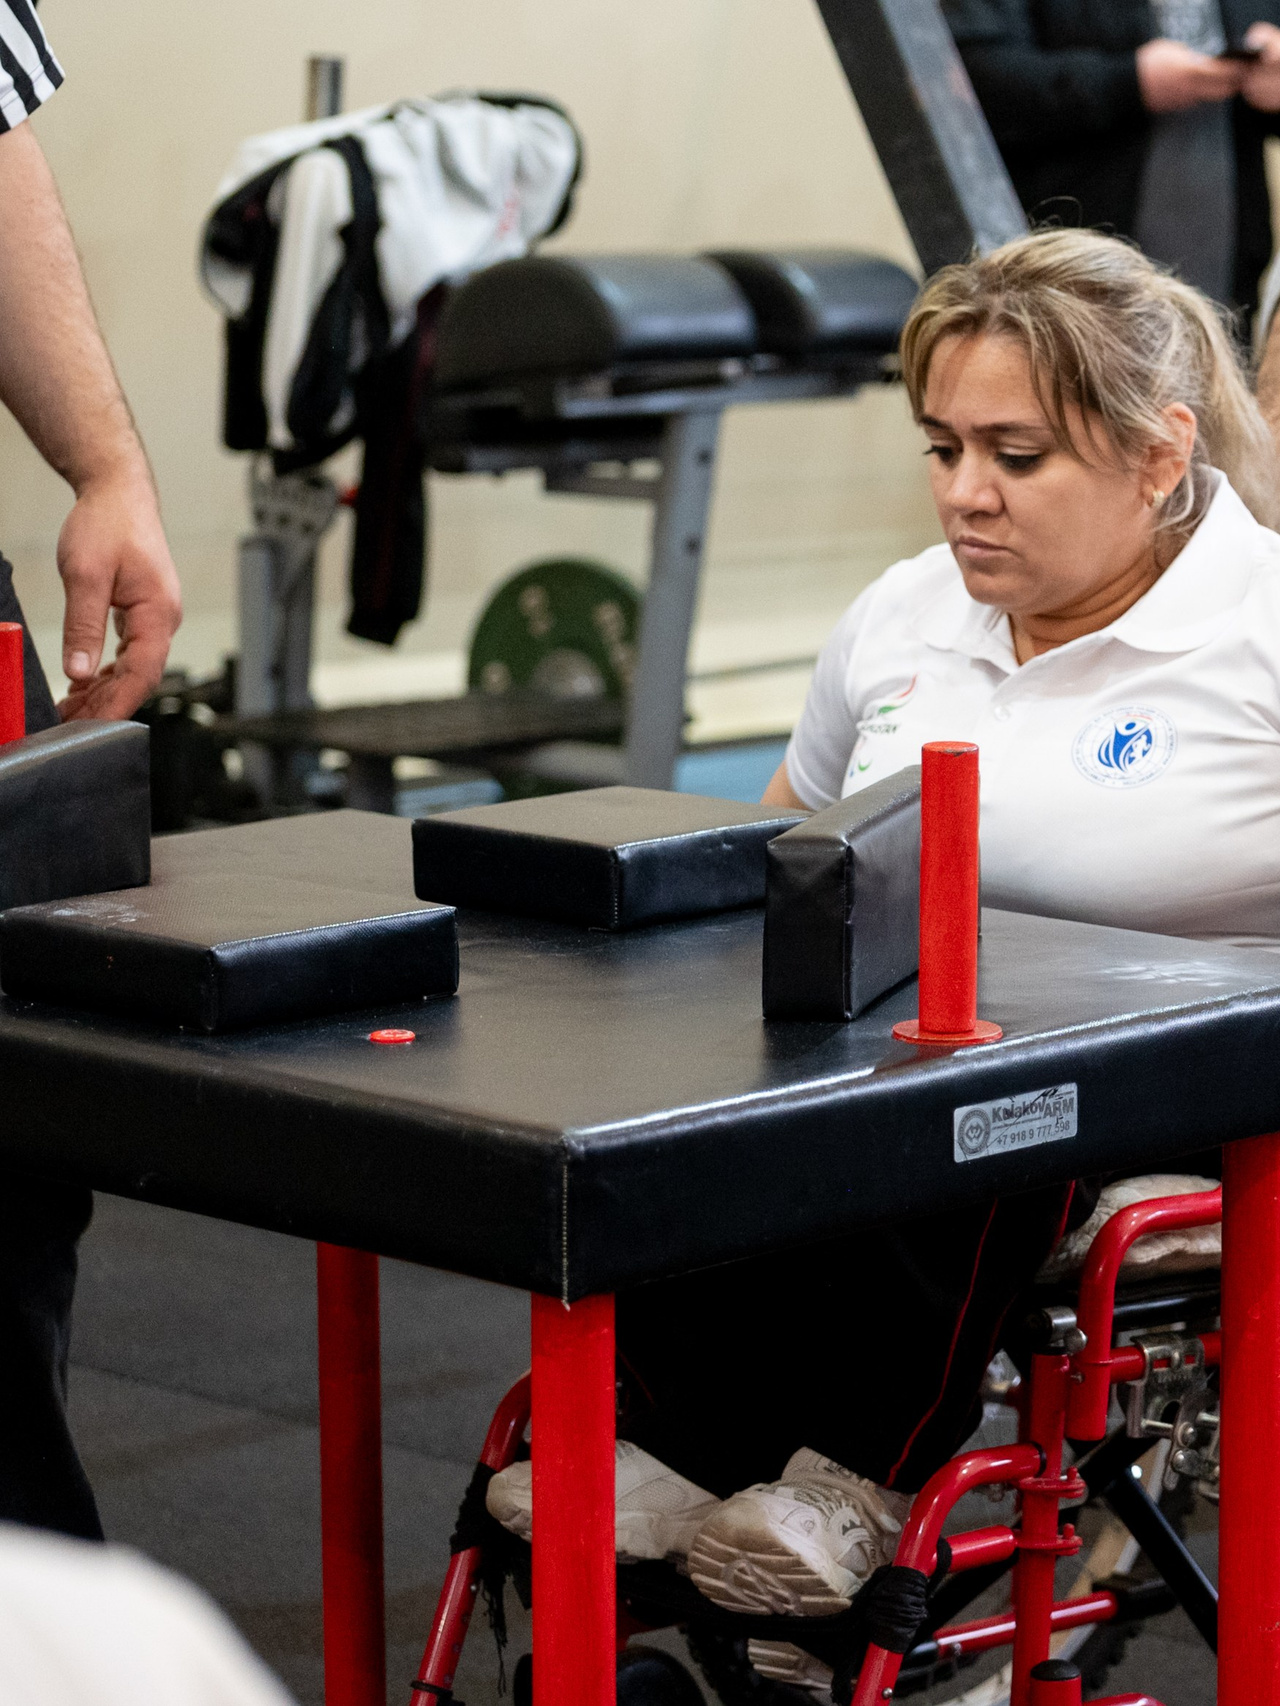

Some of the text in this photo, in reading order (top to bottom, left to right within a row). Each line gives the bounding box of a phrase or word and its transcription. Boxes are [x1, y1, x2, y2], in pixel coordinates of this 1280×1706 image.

[1010, 1129, 1026, 1143] 918
[1028, 1128, 1035, 1139] 9
[1036, 1124, 1052, 1137] 777
[1054, 1120, 1070, 1133] 598
